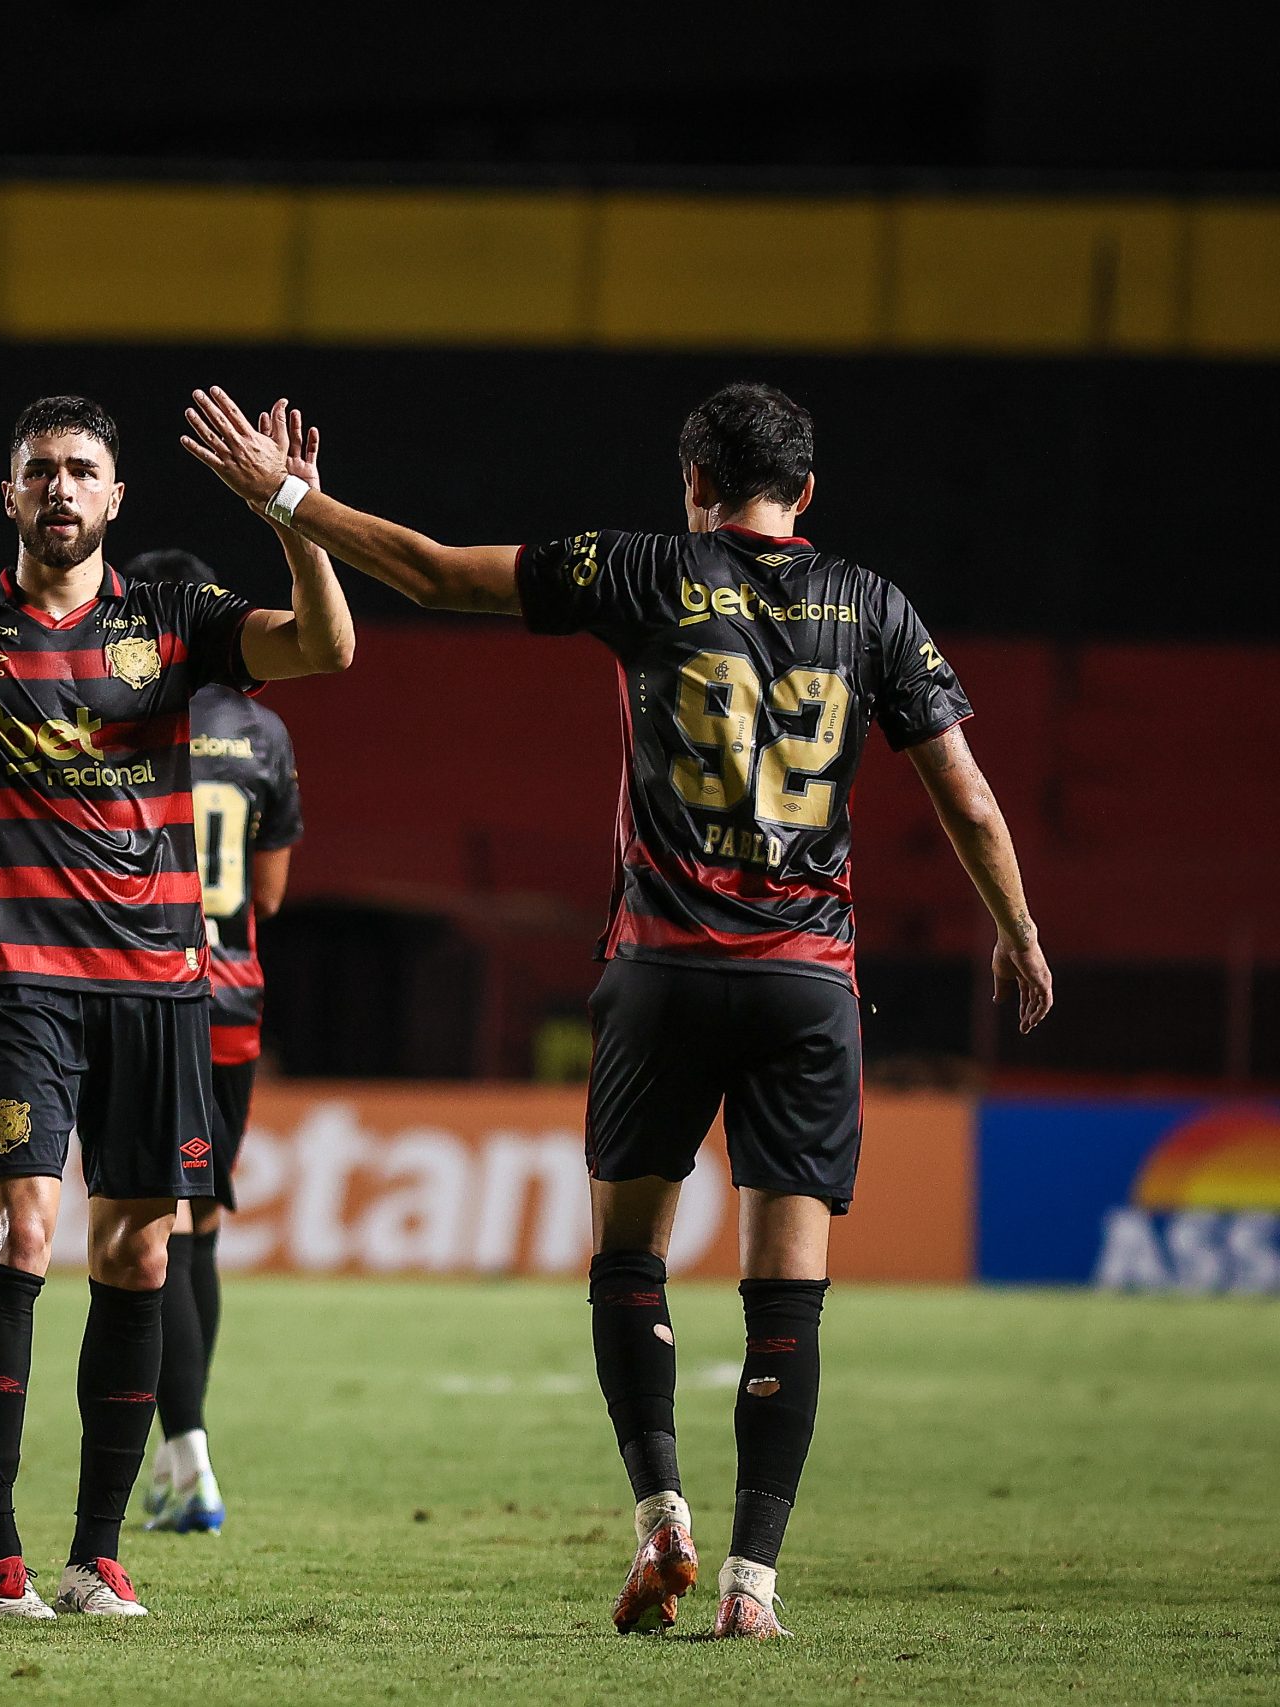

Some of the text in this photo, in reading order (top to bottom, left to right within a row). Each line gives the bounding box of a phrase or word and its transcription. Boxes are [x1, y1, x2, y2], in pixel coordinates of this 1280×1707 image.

[681, 576, 859, 624] bet nacional
[668, 647, 855, 832] 92
[46, 759, 156, 787] nacional
[183, 1159, 208, 1169] umbro
